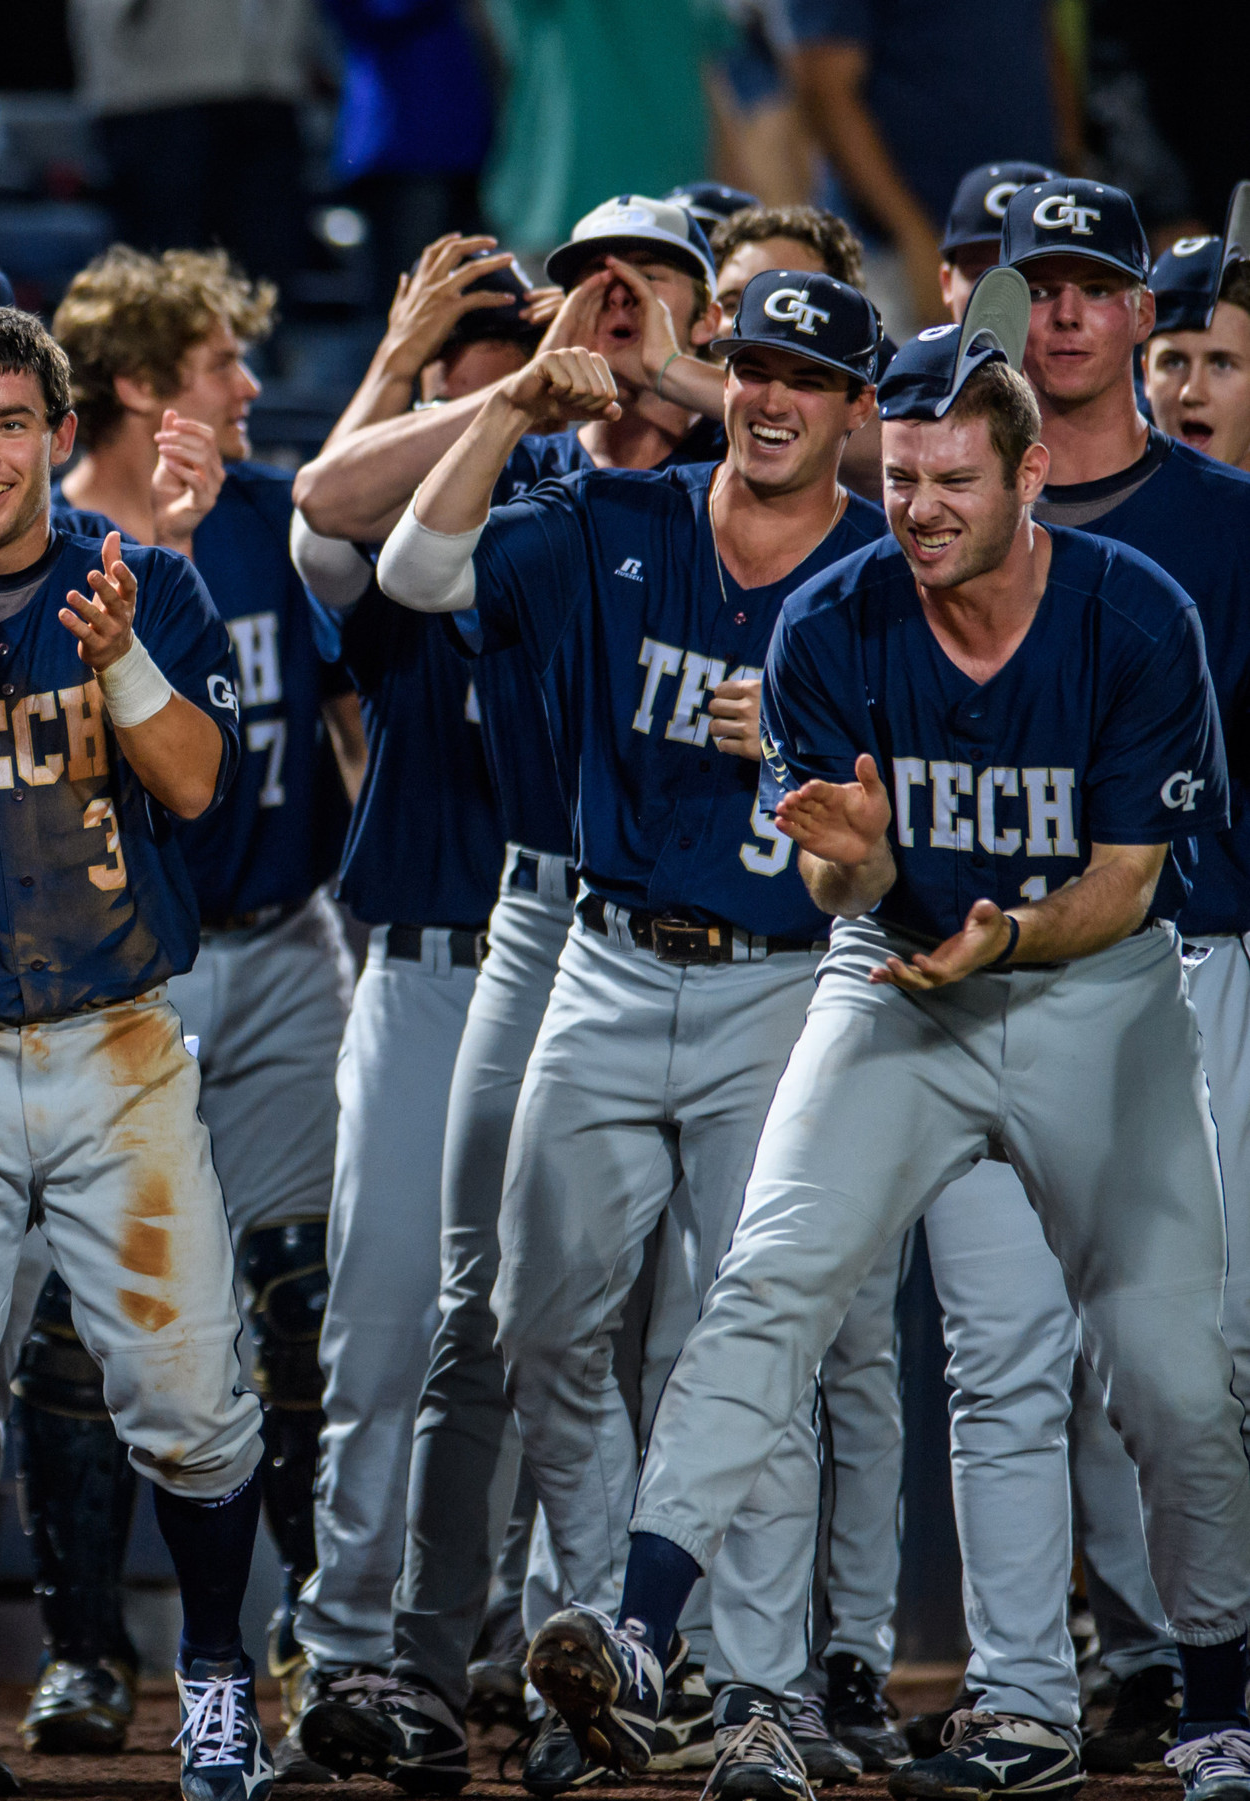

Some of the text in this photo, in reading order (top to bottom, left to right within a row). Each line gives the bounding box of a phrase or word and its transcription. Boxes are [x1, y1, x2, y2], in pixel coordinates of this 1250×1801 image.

[1033, 194, 1101, 235] GT
[764, 288, 830, 335] GT
[892, 756, 1080, 858] TECH
[1160, 769, 1205, 812] GT
[83, 797, 128, 891] 3
